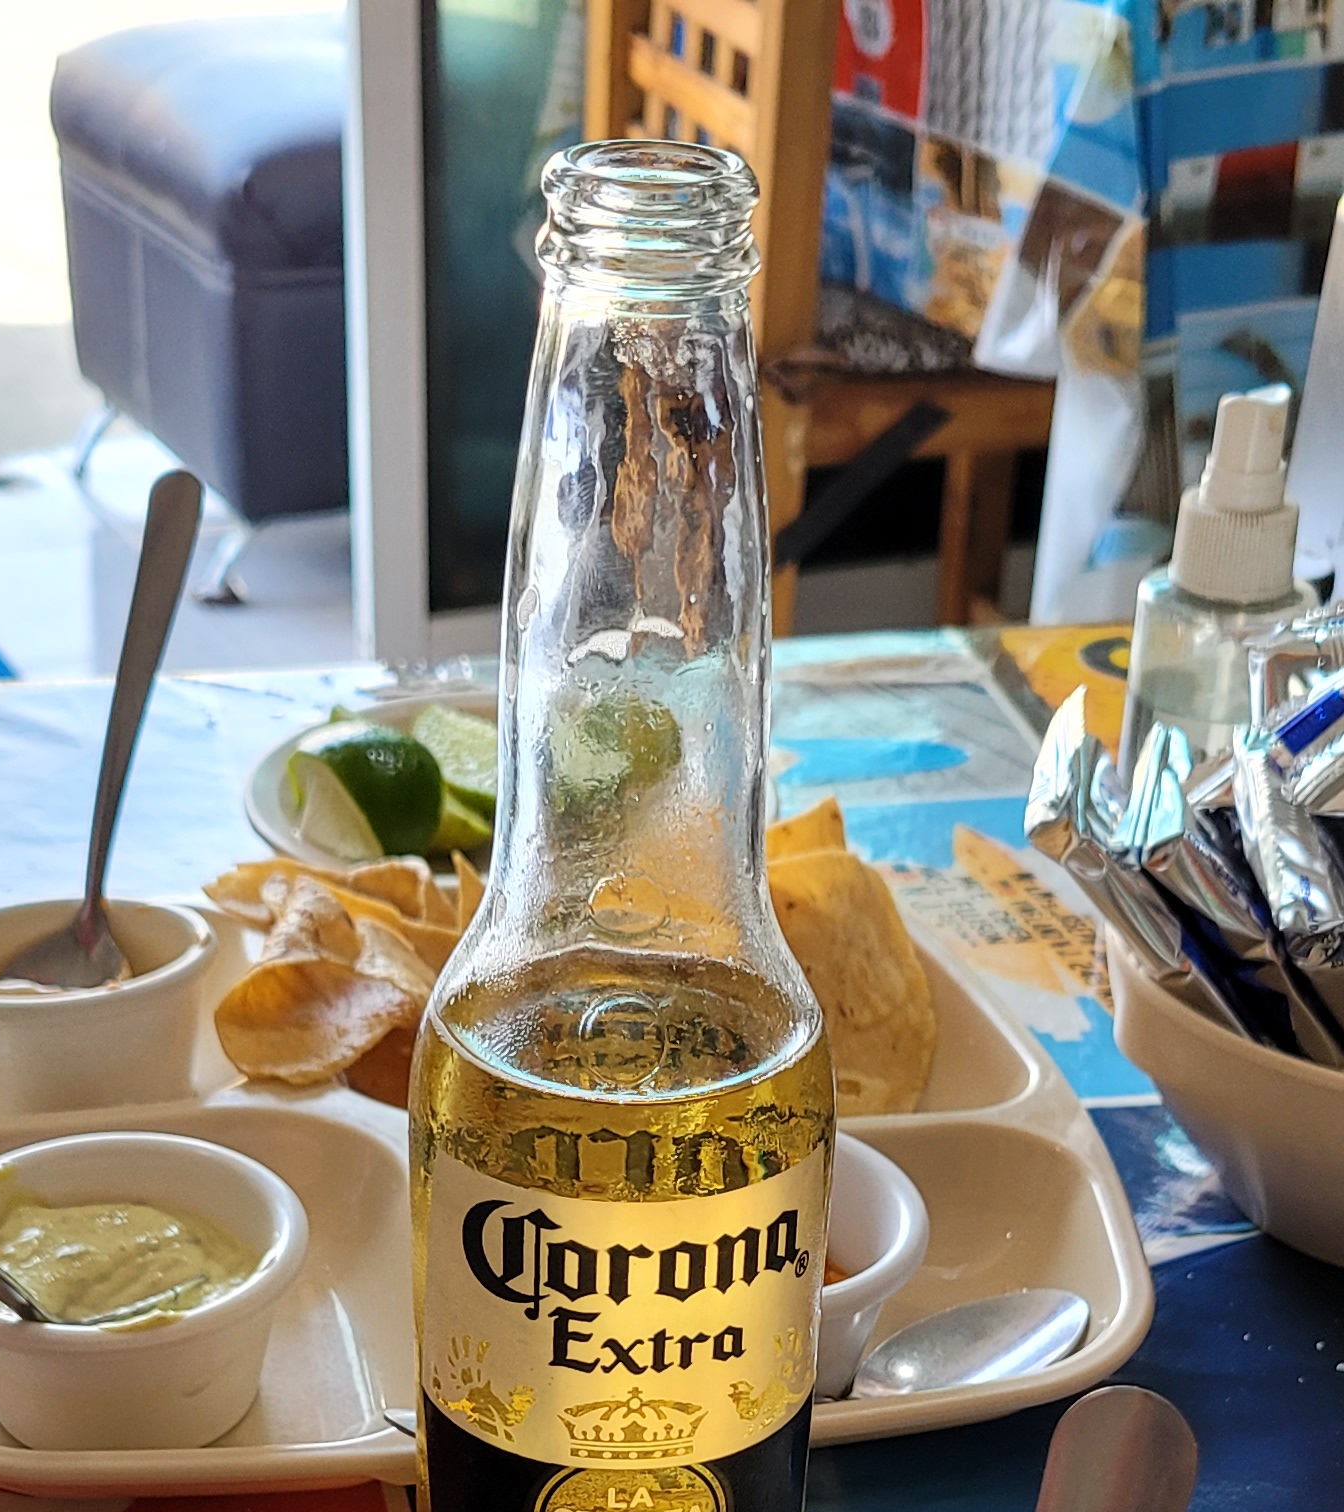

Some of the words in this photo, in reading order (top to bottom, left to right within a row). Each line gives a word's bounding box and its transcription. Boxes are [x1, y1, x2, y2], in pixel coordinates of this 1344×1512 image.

[462, 1199, 800, 1321] Corona
[548, 1306, 746, 1375] Extra
[607, 1486, 654, 1508] LA
